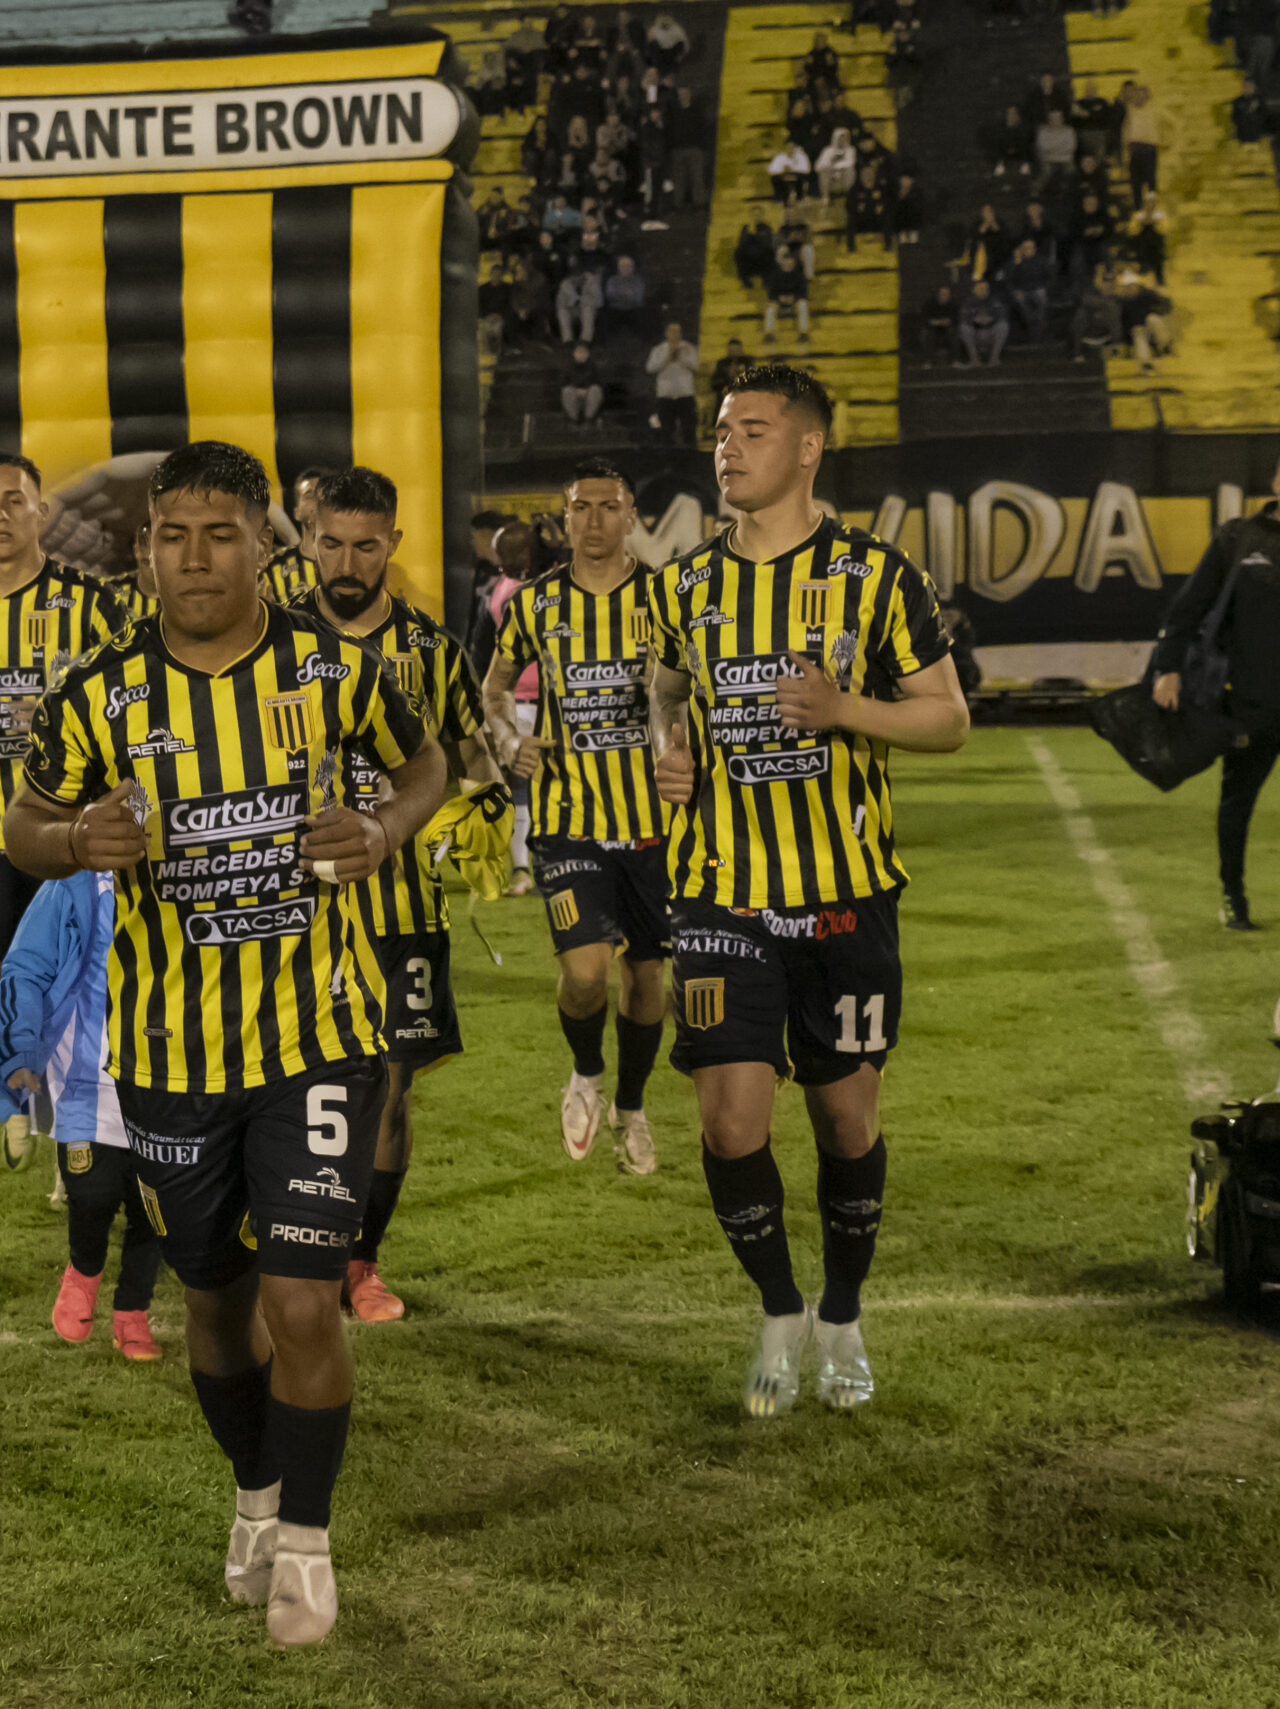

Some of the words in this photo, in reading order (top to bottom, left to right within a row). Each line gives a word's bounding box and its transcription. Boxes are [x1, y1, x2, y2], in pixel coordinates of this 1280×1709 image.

[216, 91, 424, 154] BROWN
[677, 566, 711, 594] Secco
[296, 653, 348, 684] Secco
[566, 662, 643, 682] CartaSur
[714, 656, 816, 685] CartaSu
[106, 683, 150, 719] Secco
[710, 704, 782, 724] MERCED
[0, 741, 33, 753] TAC
[594, 731, 644, 746] TACSA
[712, 726, 799, 744] POMPEYA
[127, 740, 195, 759] RETIEL
[752, 755, 822, 776] TACSA
[170, 792, 302, 832] CartaSur
[157, 844, 295, 880] MERCEDES
[162, 873, 281, 900] POMPEYA
[223, 907, 308, 935] TACSA
[406, 956, 433, 1010] 3
[834, 993, 888, 1053] 11
[306, 1084, 349, 1157] 5
[288, 1179, 357, 1204] RETIEL
[270, 1223, 349, 1249] PROCER
